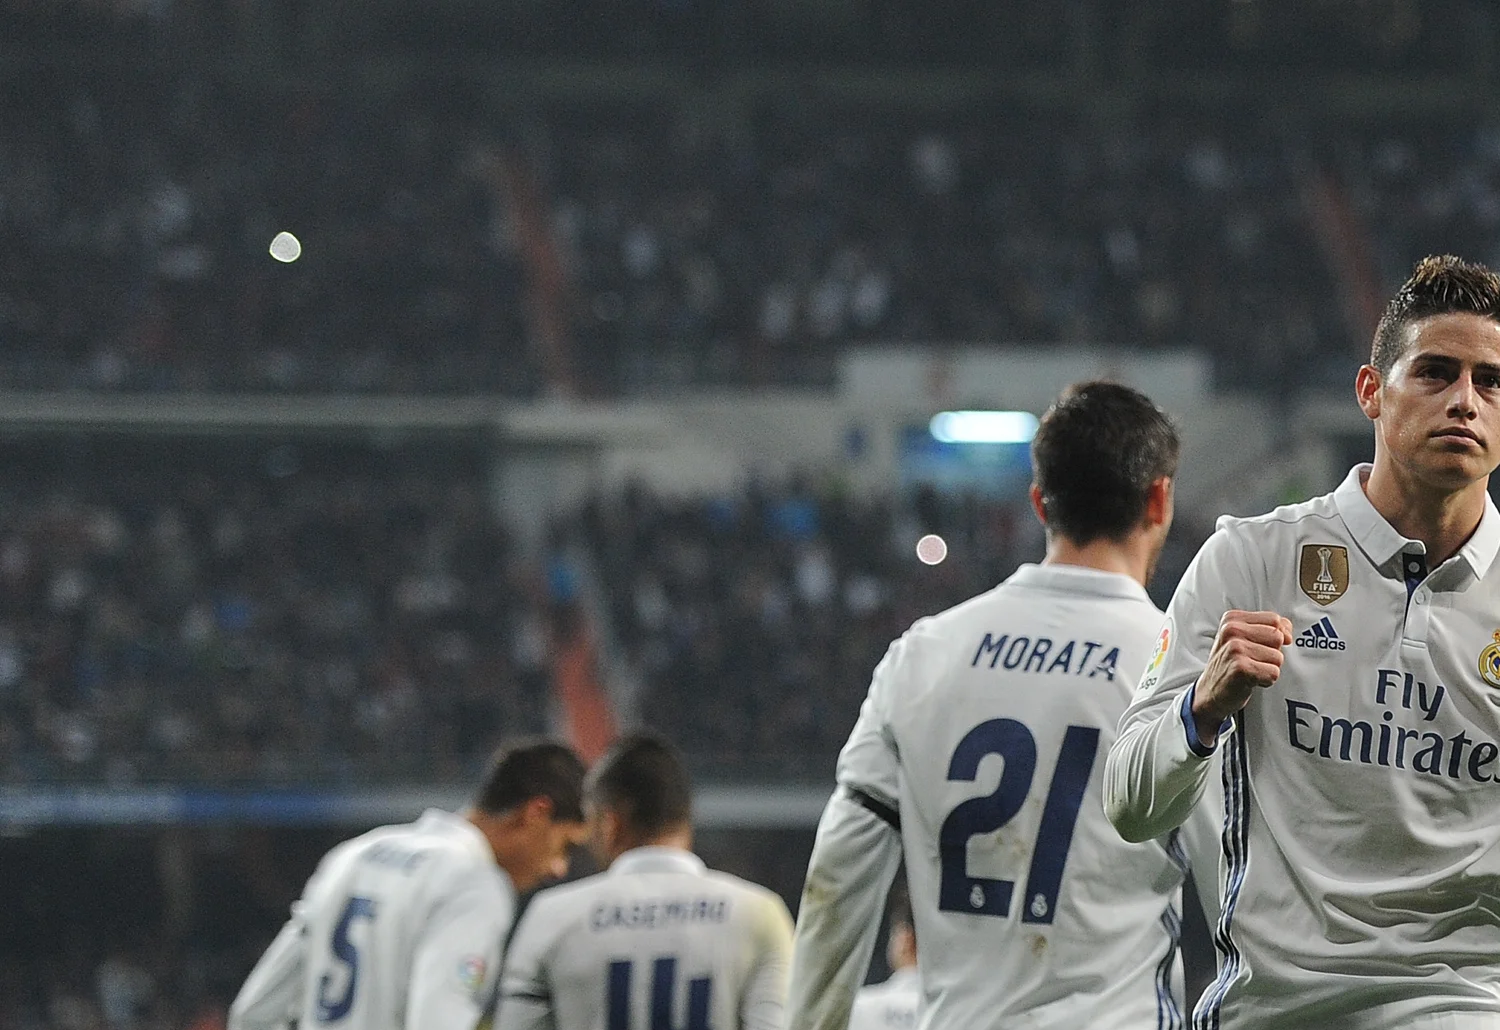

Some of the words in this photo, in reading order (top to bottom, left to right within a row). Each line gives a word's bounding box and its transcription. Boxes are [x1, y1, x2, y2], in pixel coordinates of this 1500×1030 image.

[1313, 582, 1337, 592] FIFA
[971, 632, 1120, 682] MORATA
[1295, 636, 1346, 651] adidas
[1376, 669, 1444, 721] Fly
[938, 717, 1100, 926] 21
[316, 896, 378, 1025] 5
